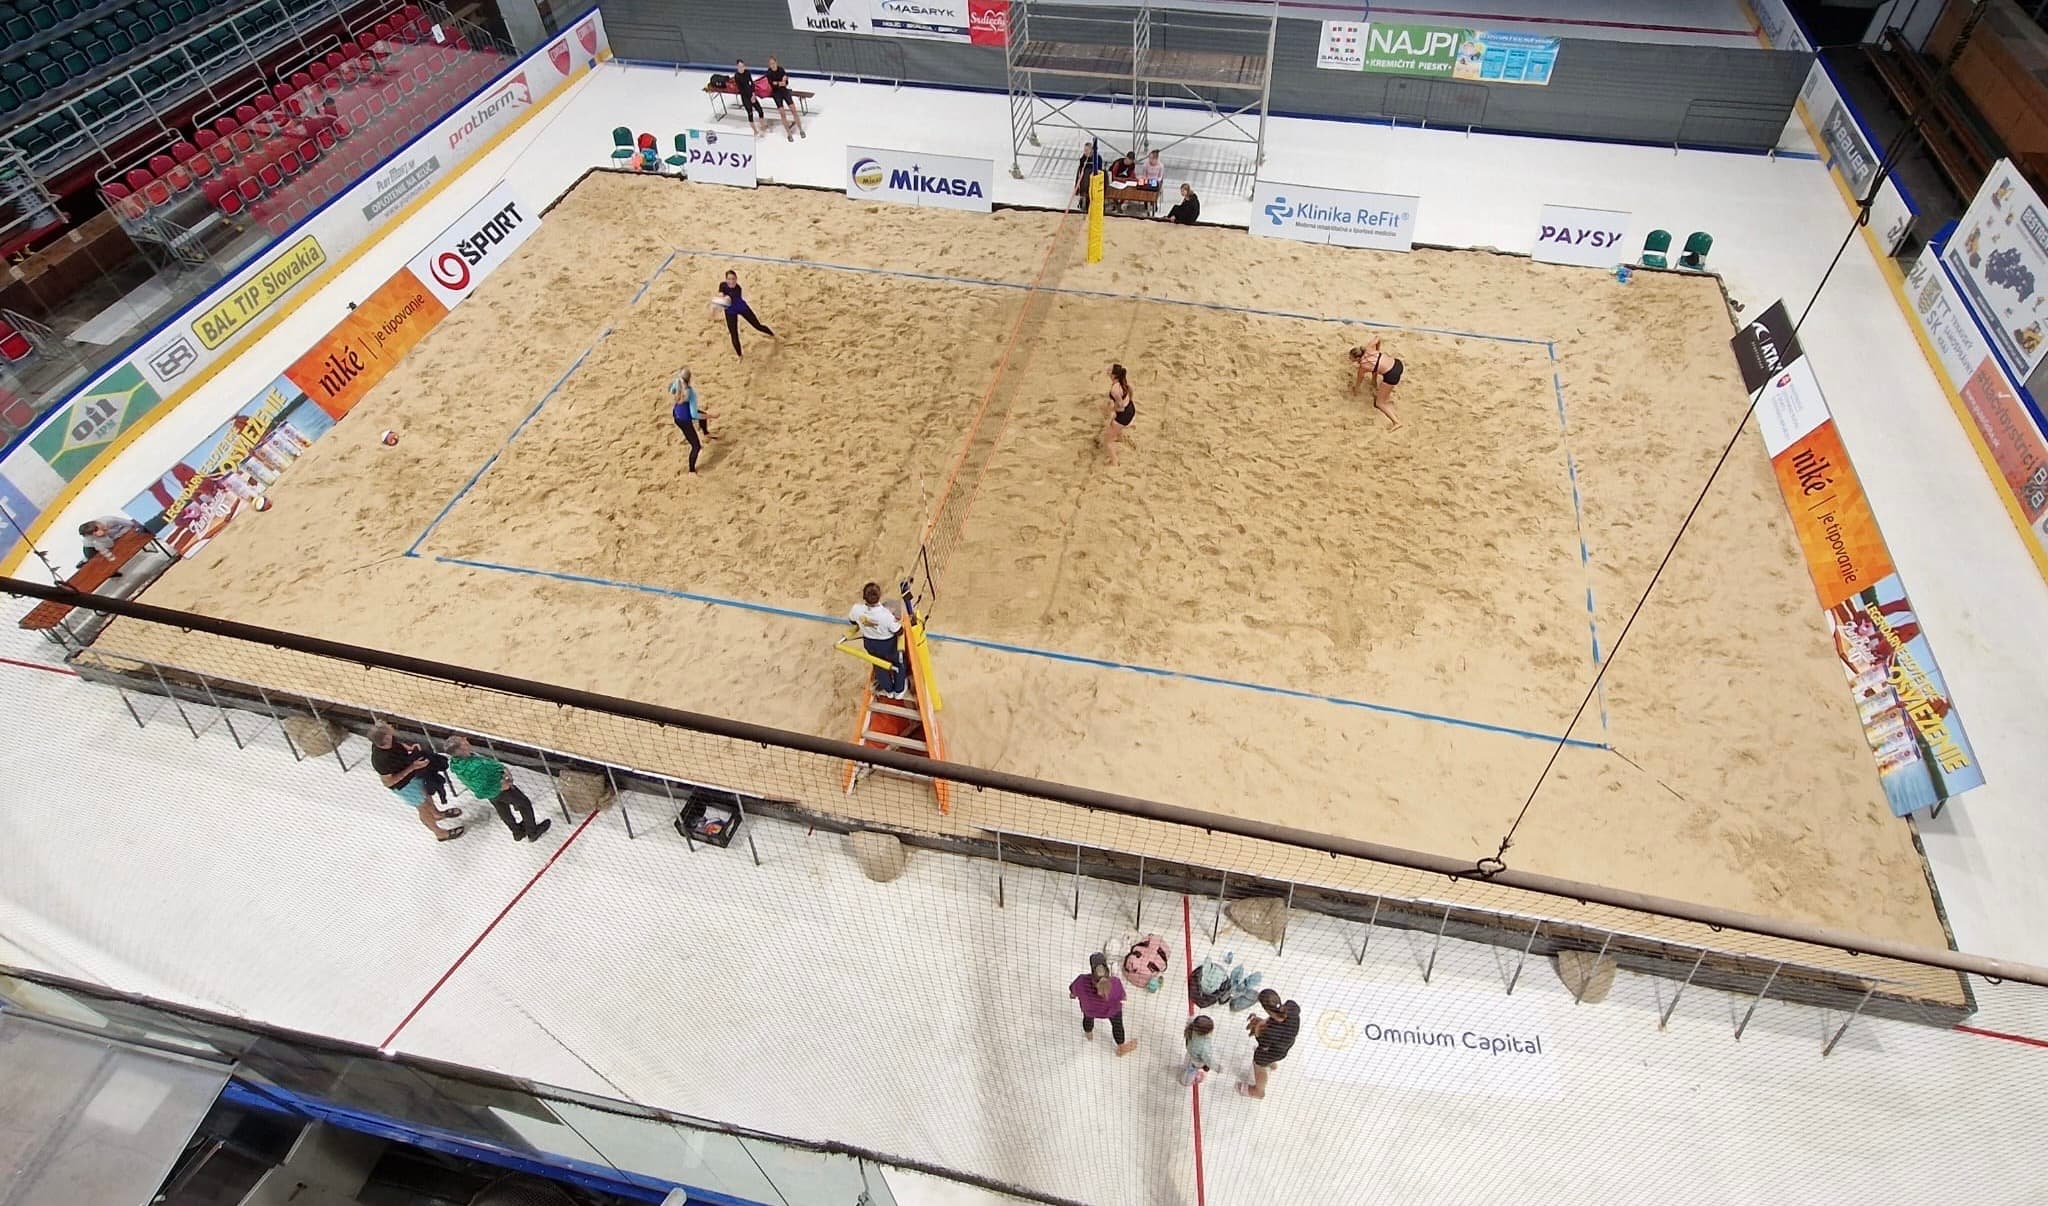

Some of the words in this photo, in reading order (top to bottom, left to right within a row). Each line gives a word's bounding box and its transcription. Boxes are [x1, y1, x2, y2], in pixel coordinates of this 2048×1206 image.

[806, 16, 846, 31] kutlak
[889, 3, 957, 18] MASARYK
[1369, 29, 1459, 58] NAJPI
[449, 90, 515, 149] protherm
[689, 149, 753, 169] PAYSY
[1297, 203, 1352, 224] Klinika
[456, 201, 524, 266] ŠPORT
[1539, 225, 1622, 248] PAYSY
[202, 307, 237, 342] BAL
[233, 285, 260, 316] TIP
[261, 246, 321, 296] Slovakia
[383, 293, 425, 334] tipovanie
[319, 345, 365, 398] niké
[1792, 447, 1834, 497] niké
[1825, 525, 1858, 585] tipovanie
[1364, 1023, 1456, 1048] Omnium
[1462, 1032, 1543, 1056] Capital
